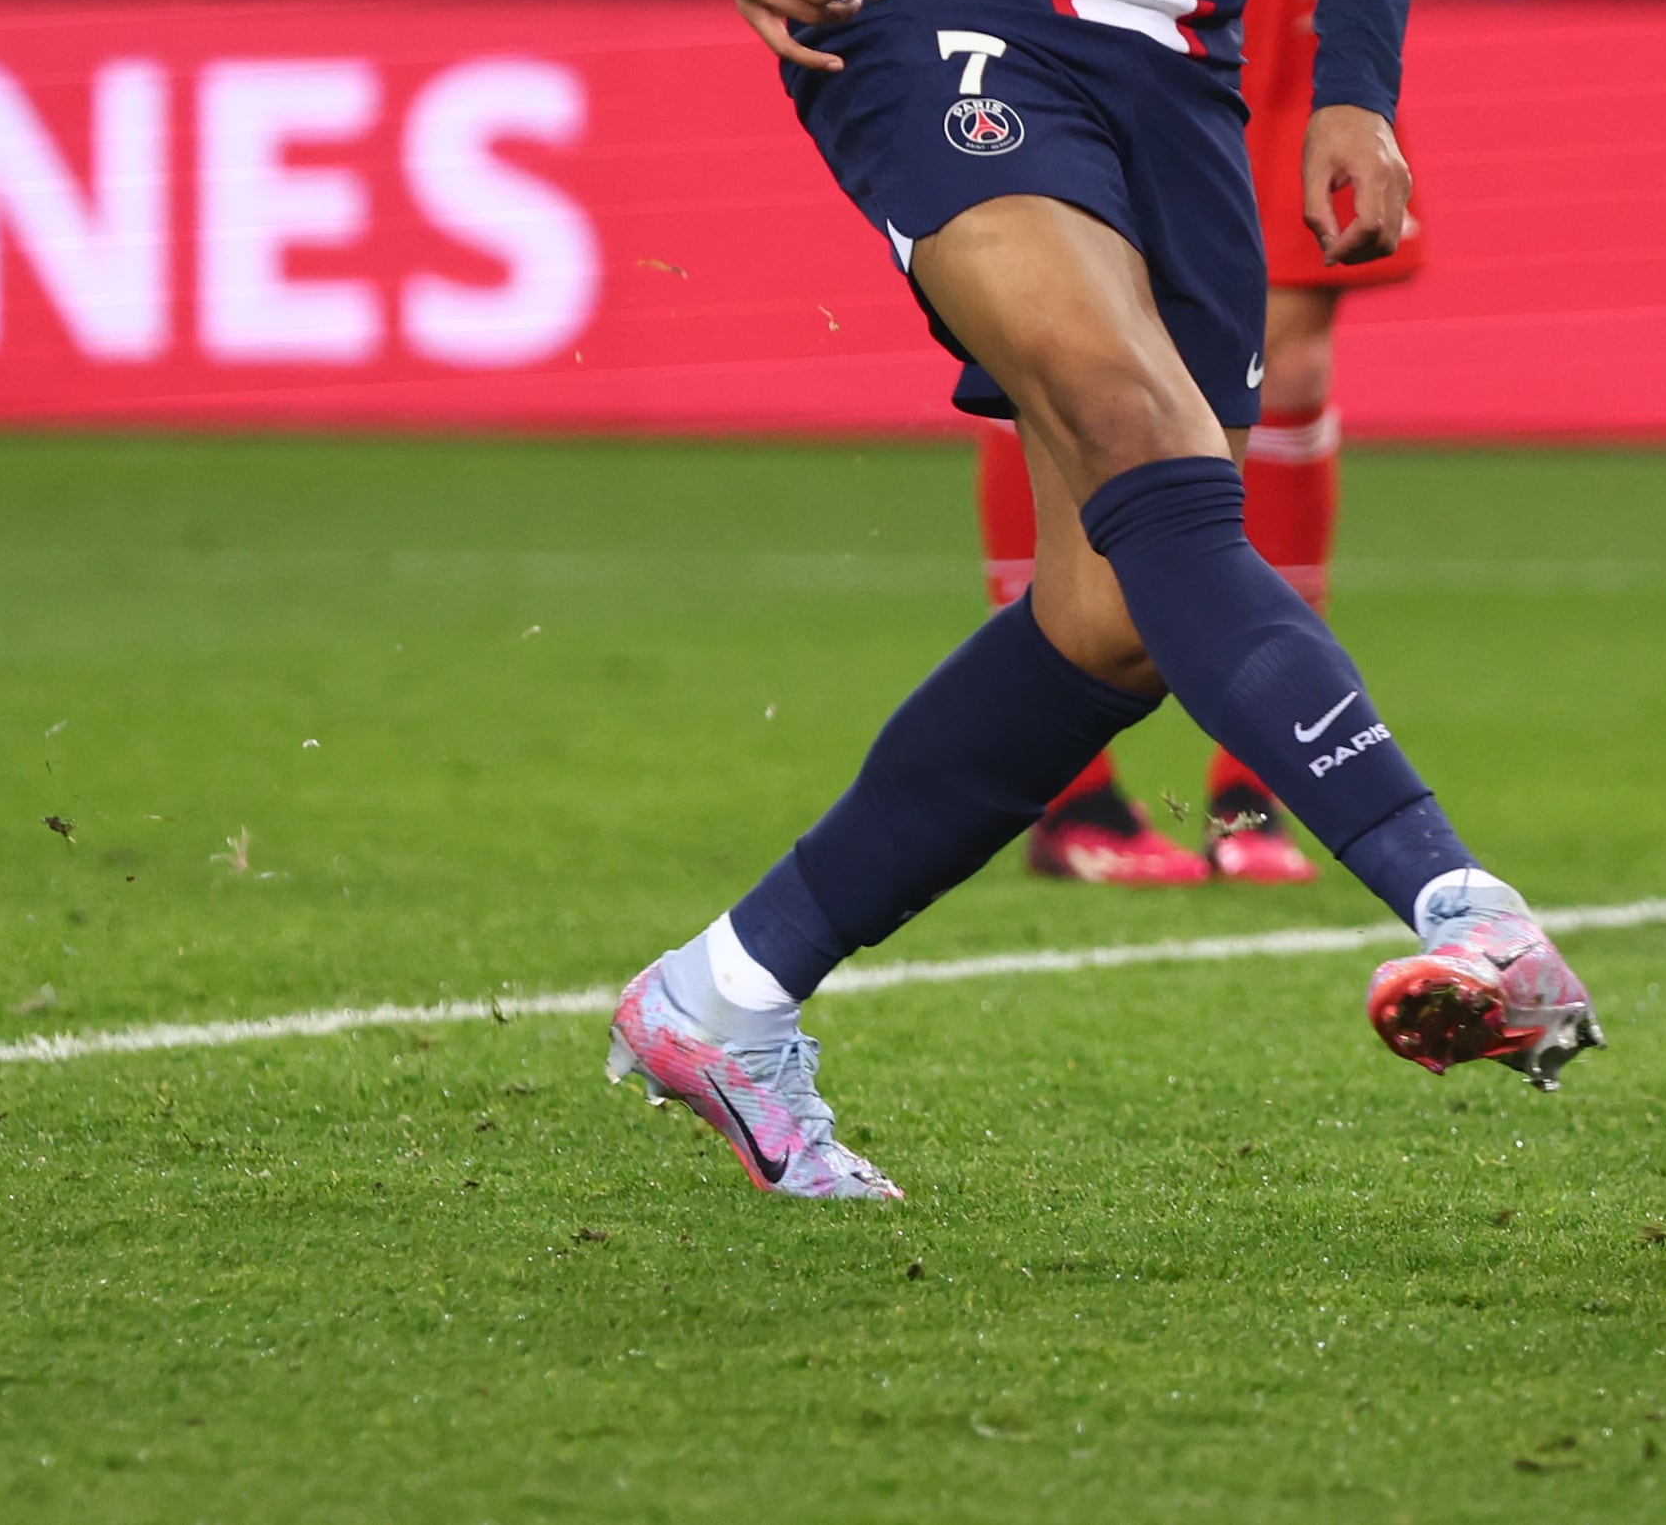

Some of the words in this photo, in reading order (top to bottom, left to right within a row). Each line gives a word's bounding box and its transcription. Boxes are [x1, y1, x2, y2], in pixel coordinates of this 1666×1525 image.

[936, 30, 1007, 95] 7
[952, 99, 1004, 118] PARIS
[1308, 722, 1392, 778] PARIS
